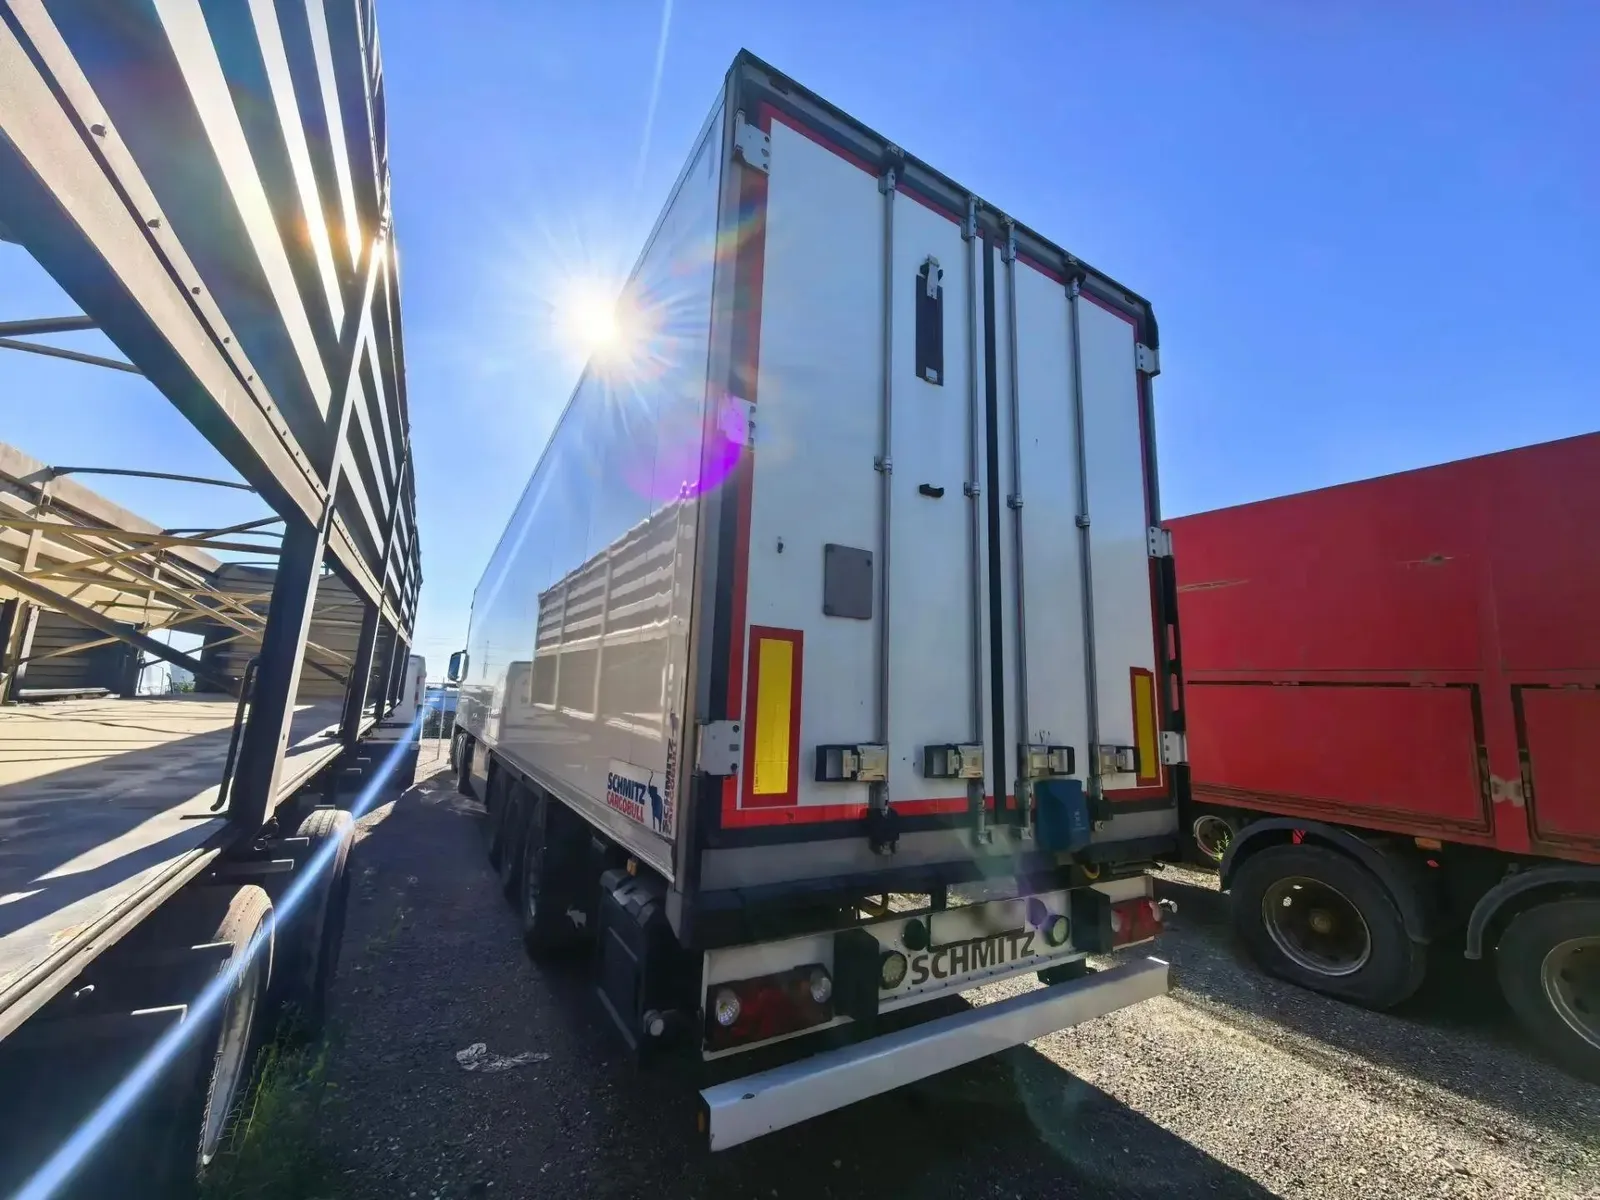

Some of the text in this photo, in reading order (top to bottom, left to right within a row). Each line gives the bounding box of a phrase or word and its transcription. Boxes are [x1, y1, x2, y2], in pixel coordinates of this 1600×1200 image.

[607, 772, 646, 805] SCHMITZ
[607, 791, 645, 823] CARGOBULL
[911, 931, 1035, 985] SCHMITZ
